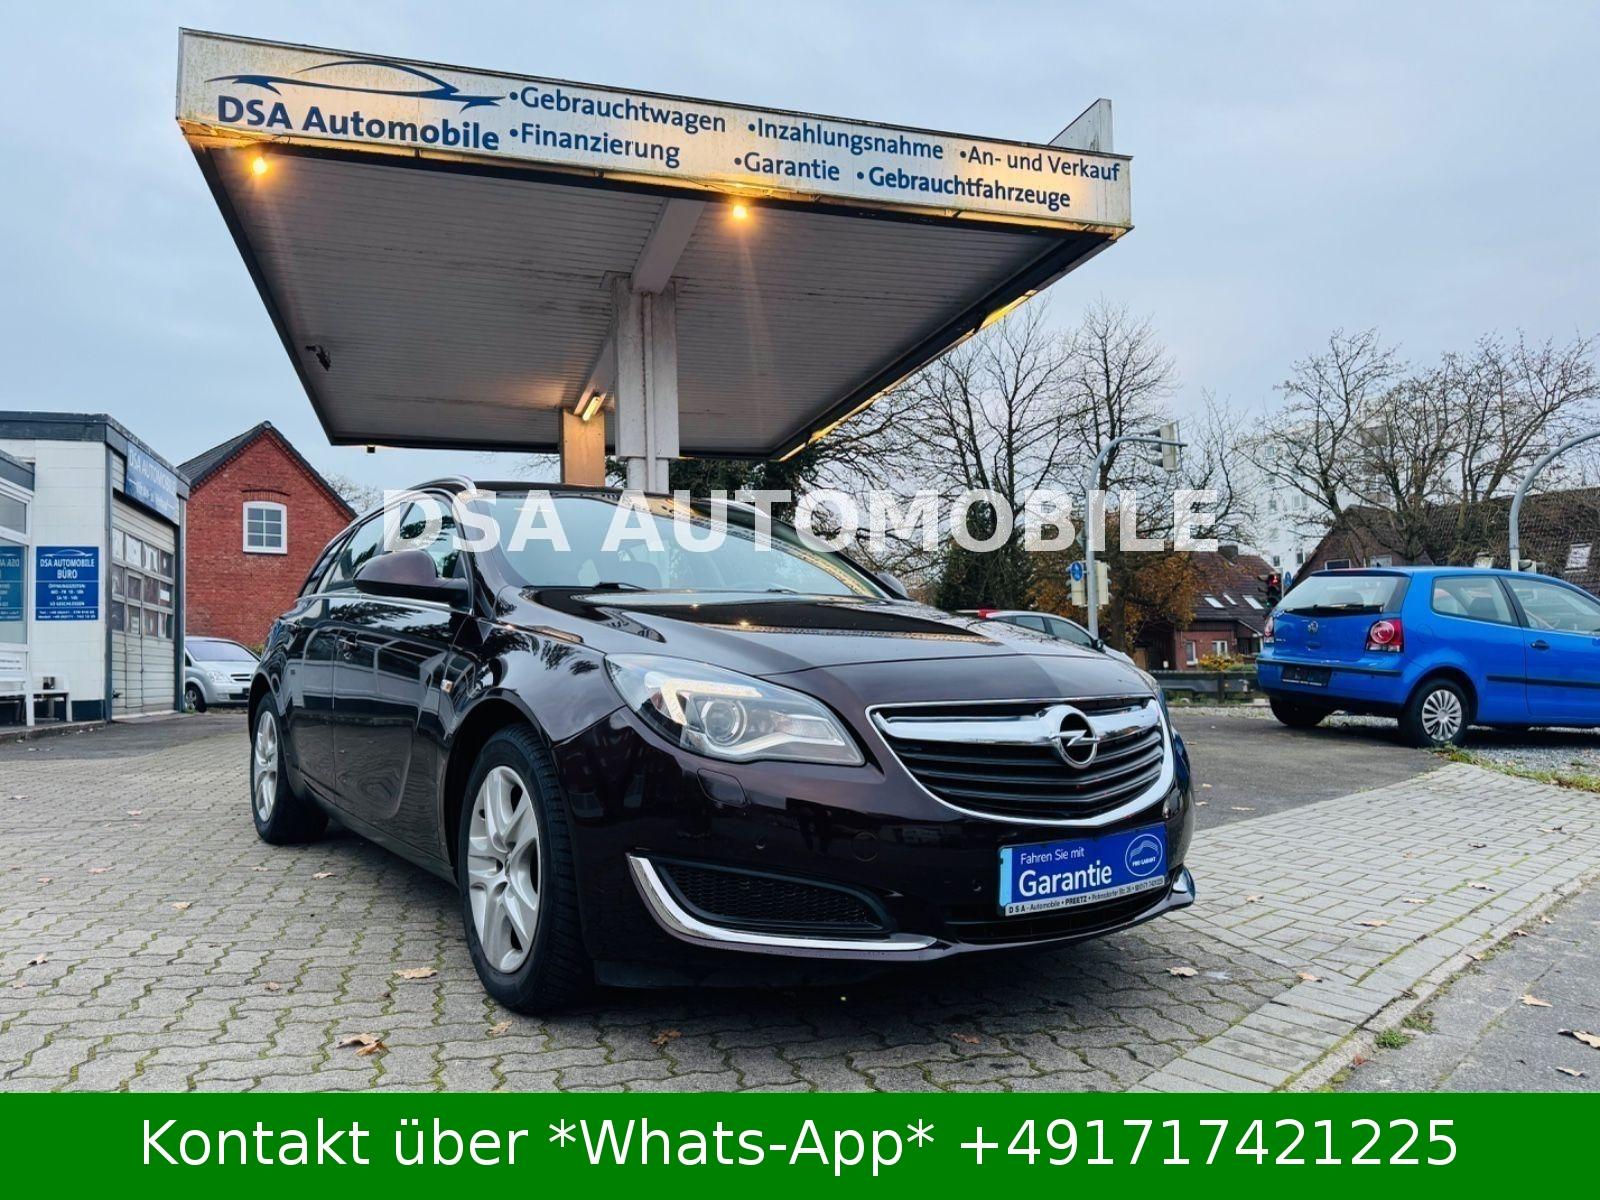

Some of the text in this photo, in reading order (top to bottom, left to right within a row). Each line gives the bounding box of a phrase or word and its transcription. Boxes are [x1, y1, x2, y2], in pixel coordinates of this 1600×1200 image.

[217, 95, 500, 151] DSA Automobile
[521, 86, 726, 134] Gebrauchtwagen
[521, 123, 680, 169] Finanzierung
[757, 117, 944, 160] Inzahlungsnahme
[743, 151, 841, 182] Garantie
[966, 145, 1121, 182] An- und Verkauf
[868, 166, 1072, 211] Gebrauchtfahrzeuge
[40, 558, 95, 568] DSA AUTOMOBILE
[57, 567, 78, 579] BÜRO
[1020, 847, 1085, 865] Fahren Sie mit
[1018, 860, 1113, 897] Garantie
[1065, 895, 1088, 906] PREETZ
